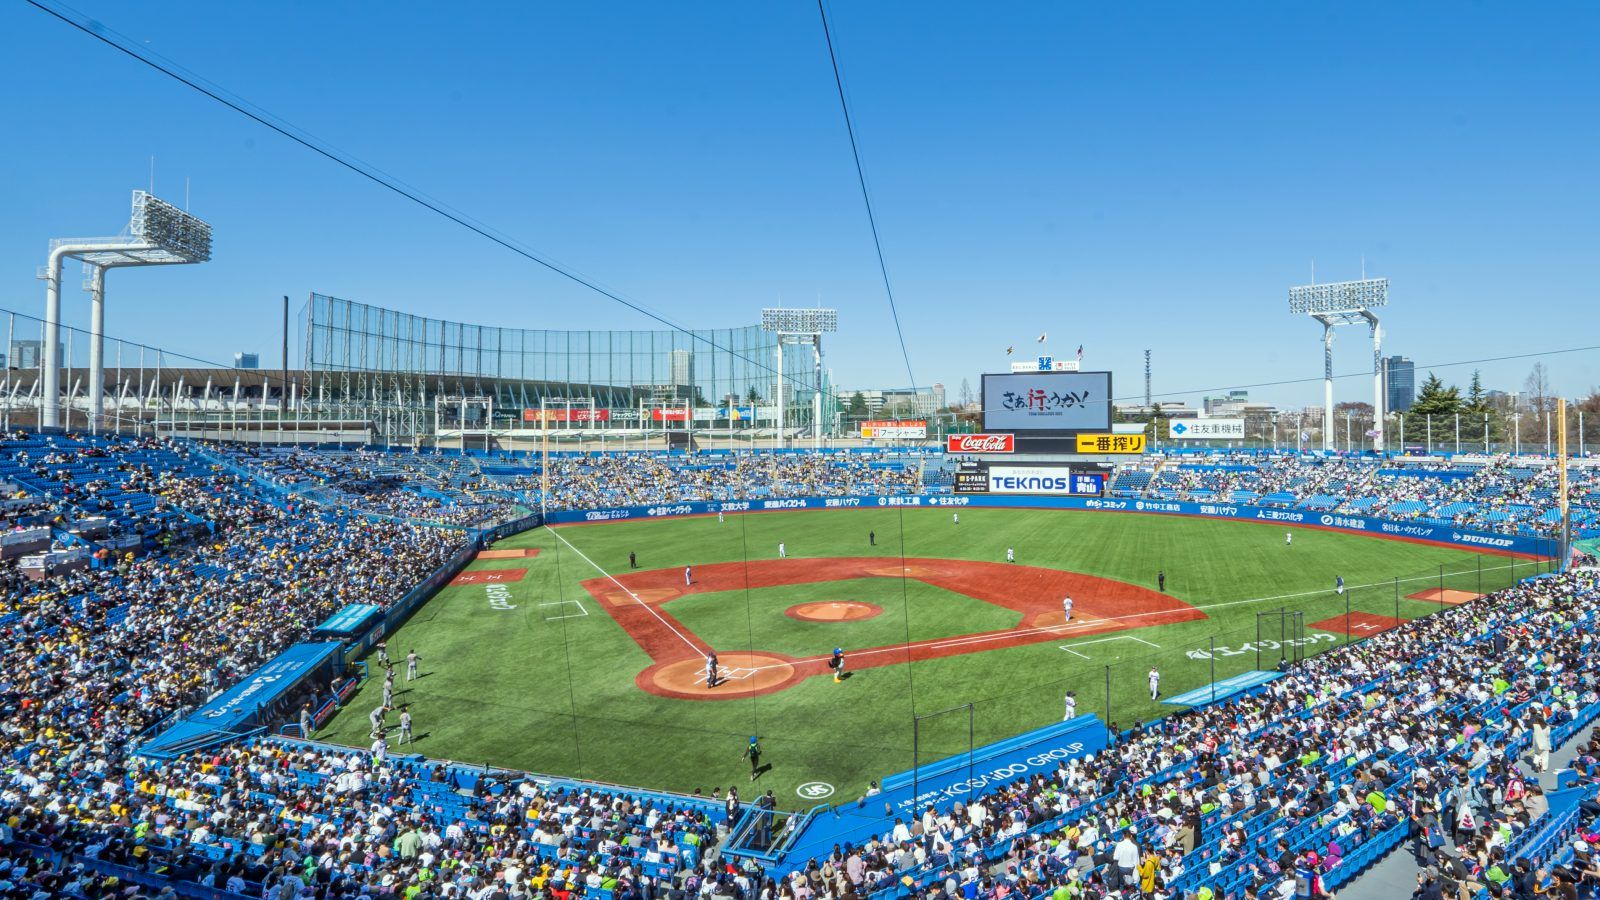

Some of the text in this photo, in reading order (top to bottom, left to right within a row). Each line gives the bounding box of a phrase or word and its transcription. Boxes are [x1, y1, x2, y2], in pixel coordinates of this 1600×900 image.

[881, 429, 925, 437] フーシャース
[1190, 423, 1242, 434] 住友重機械
[960, 435, 1008, 451] Coca-Cola
[1081, 436, 1141, 451] 一番搾り
[992, 477, 1066, 489] TEKNOS
[720, 502, 750, 511] 文教大学
[825, 498, 860, 507] 安藤ハザマ
[888, 497, 920, 505] 東鉄工業
[939, 497, 969, 505] 住友化学
[656, 506, 692, 516] 住友ベークライト
[1145, 502, 1181, 512] 竹中工務店
[1200, 505, 1238, 516] 安藤ハザマ
[1266, 510, 1304, 522] 三菱ガス化学
[1334, 516, 1365, 529] 清水建設
[1387, 523, 1433, 537] 日本ハウズイング
[1461, 534, 1514, 547] DUNLOP
[1026, 742, 1084, 766] GROUP
